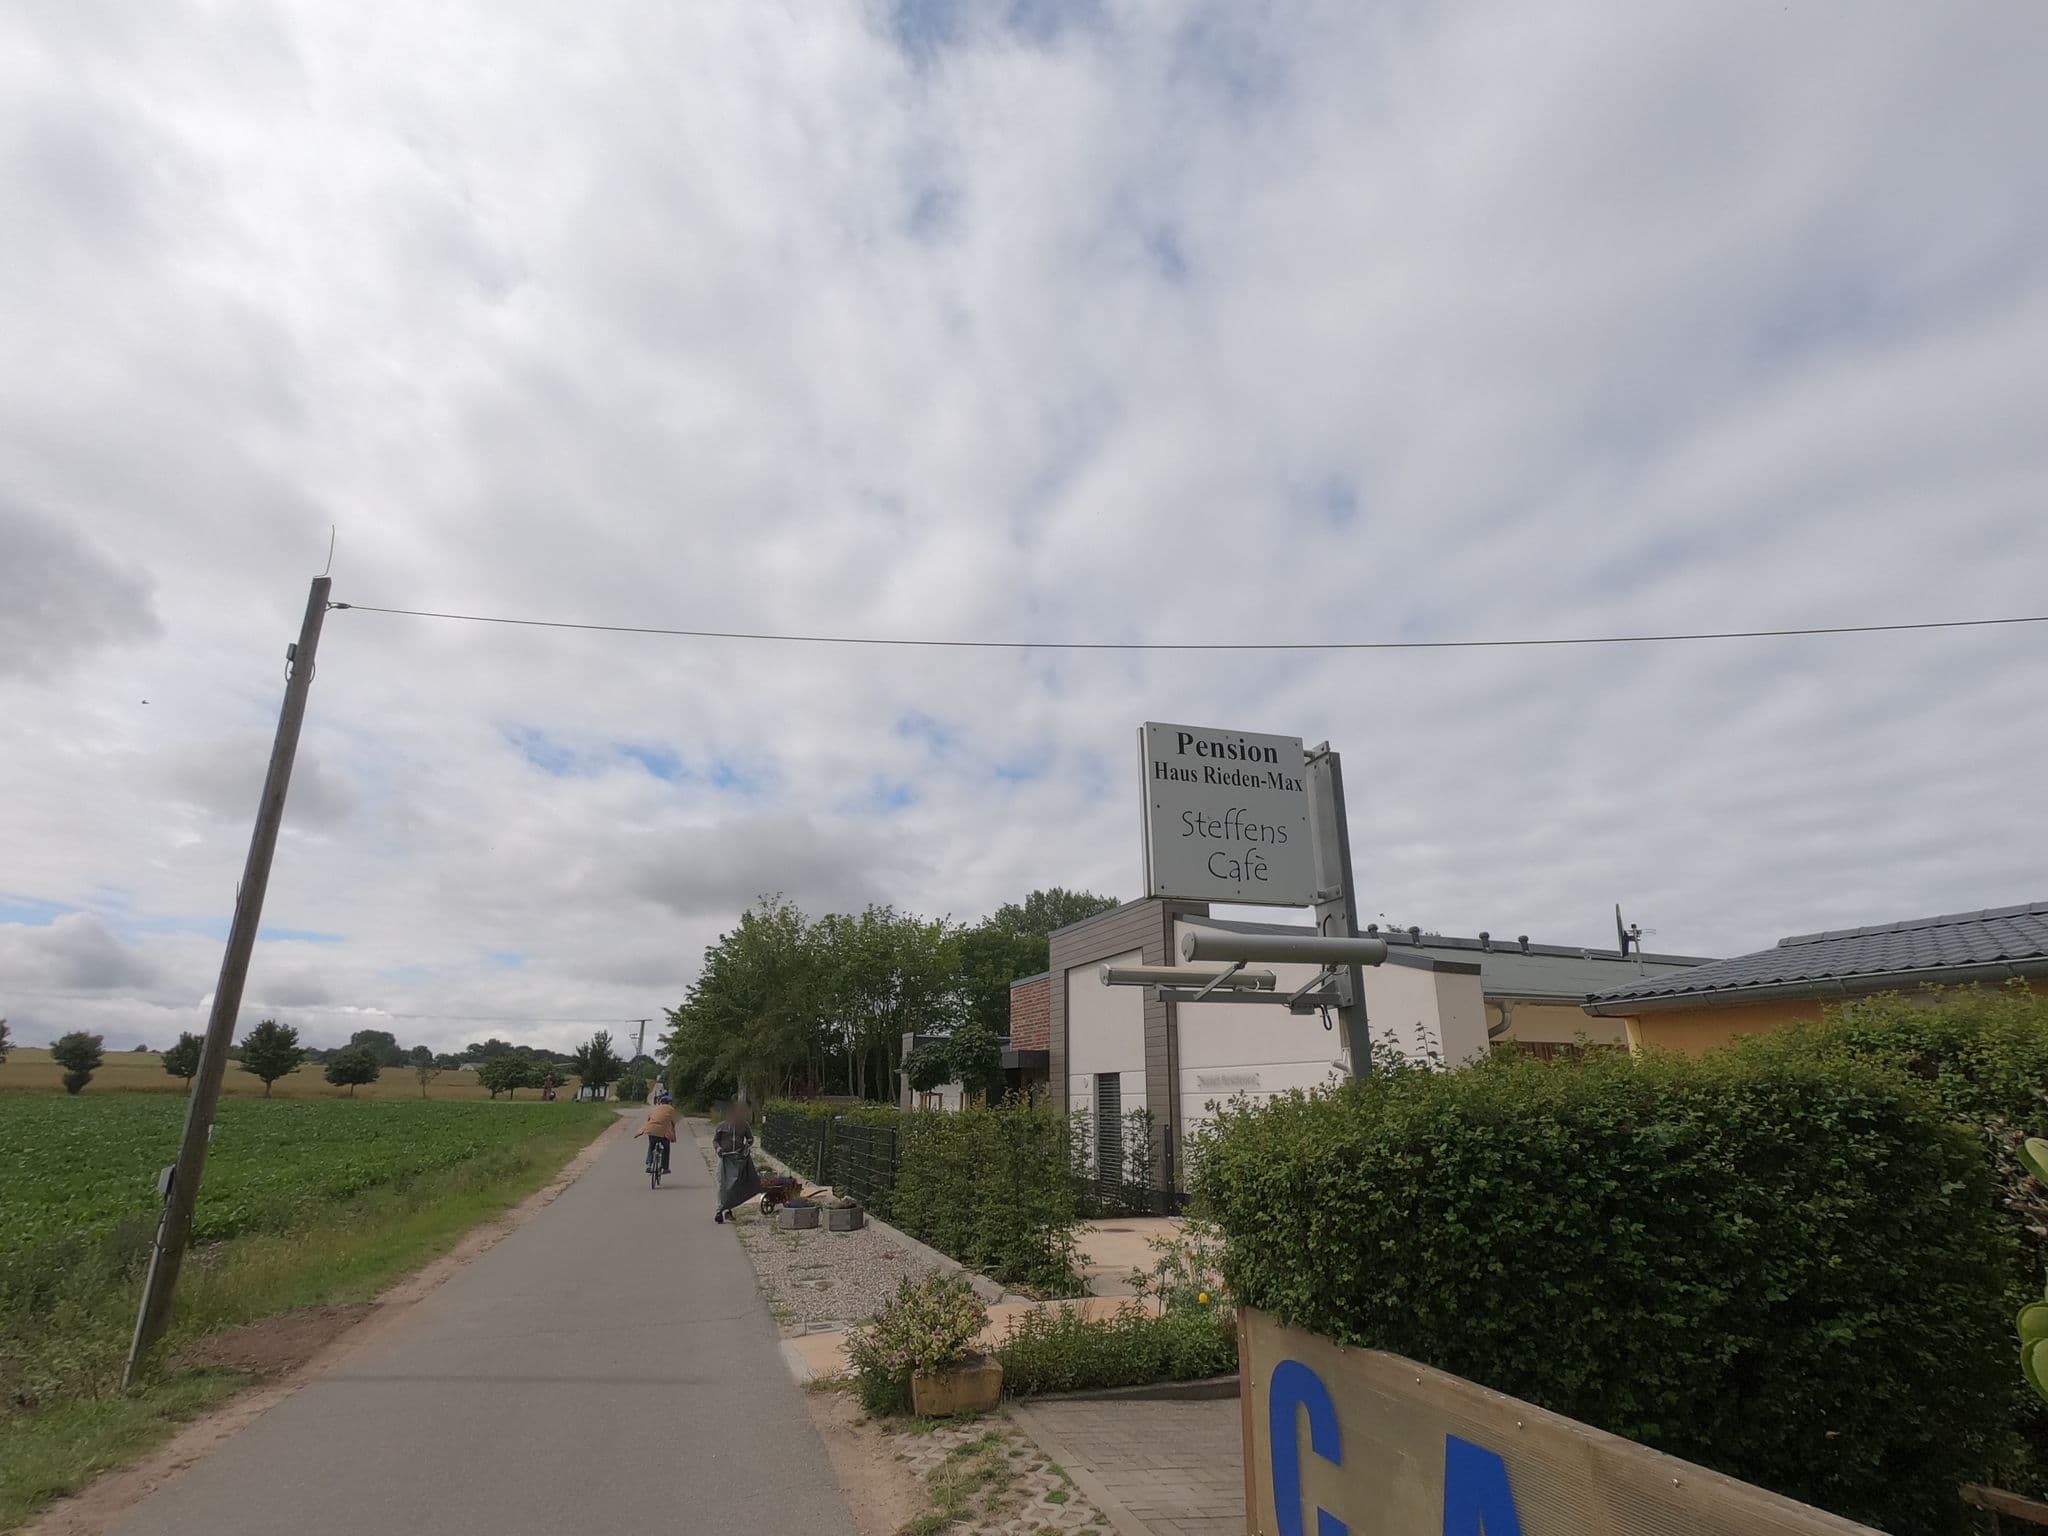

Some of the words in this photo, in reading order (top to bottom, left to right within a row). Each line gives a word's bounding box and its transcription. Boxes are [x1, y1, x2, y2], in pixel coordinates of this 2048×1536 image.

[1176, 731, 1279, 764] Pension
[1154, 761, 1198, 783] Haus
[1204, 765, 1303, 792] Rieden-Max
[1181, 807, 1288, 844] Steffens
